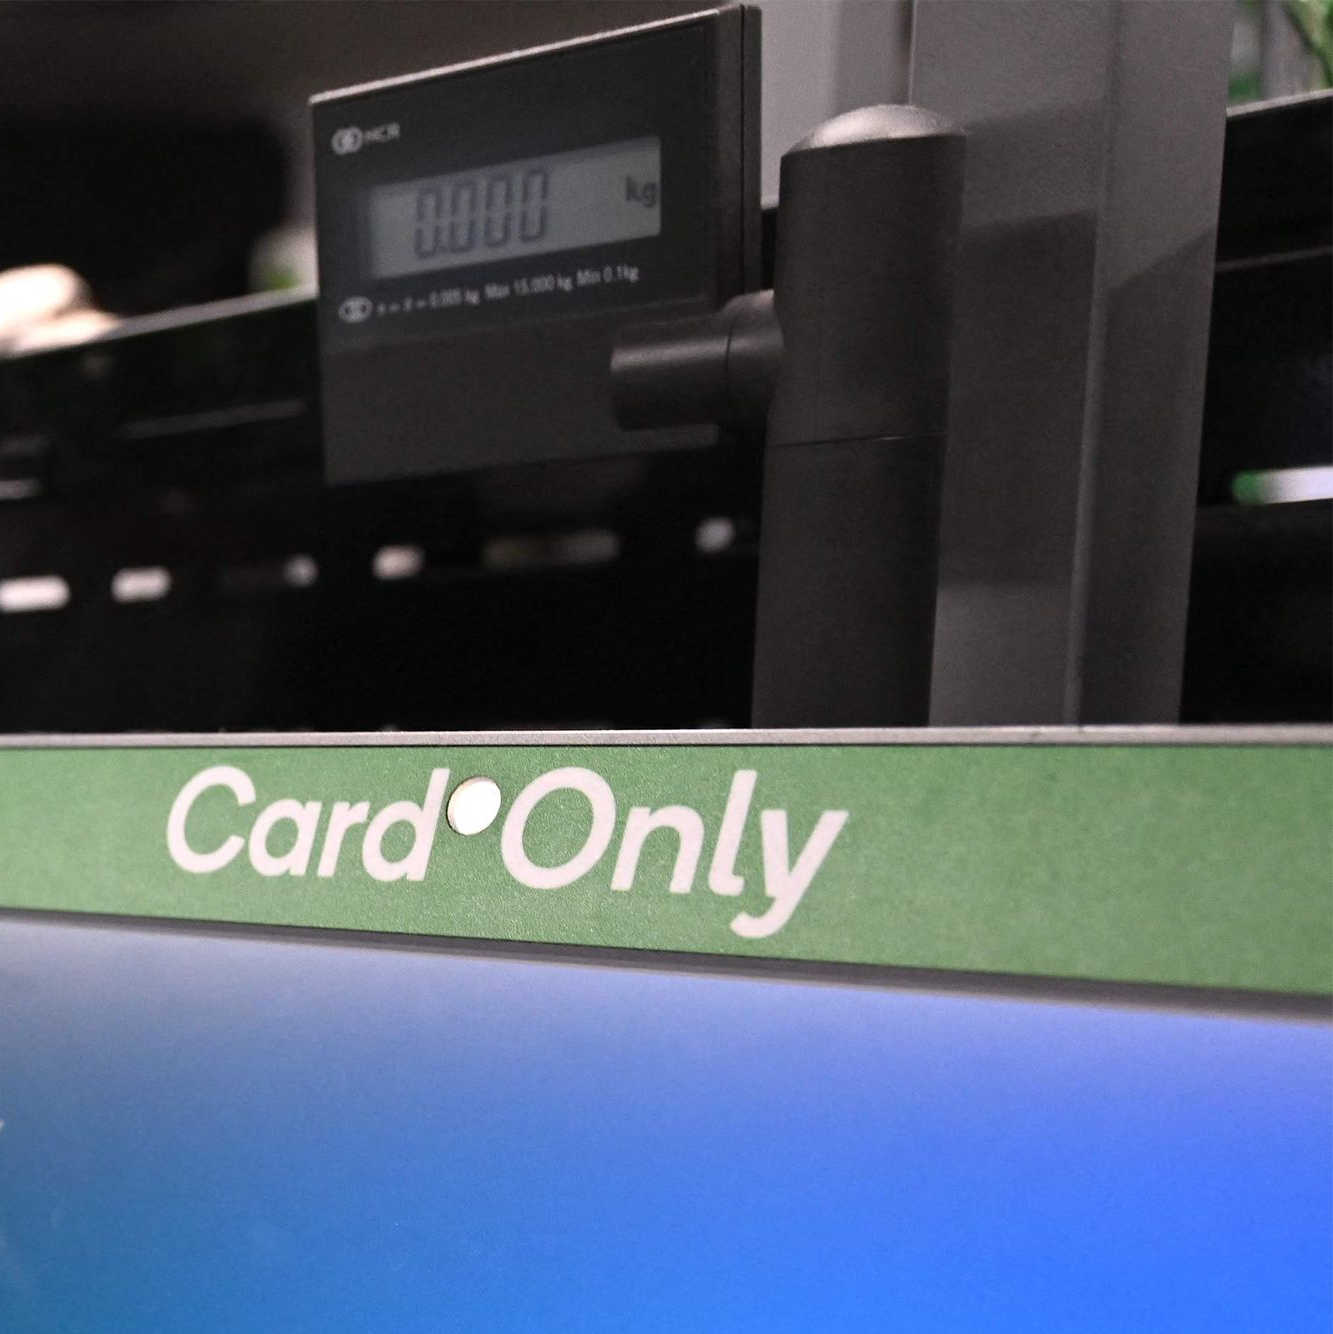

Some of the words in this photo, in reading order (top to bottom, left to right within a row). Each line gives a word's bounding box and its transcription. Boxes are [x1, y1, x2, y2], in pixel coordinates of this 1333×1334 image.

[413, 166, 548, 259] 0.000
[166, 764, 451, 883] Card
[500, 765, 850, 939] Only
